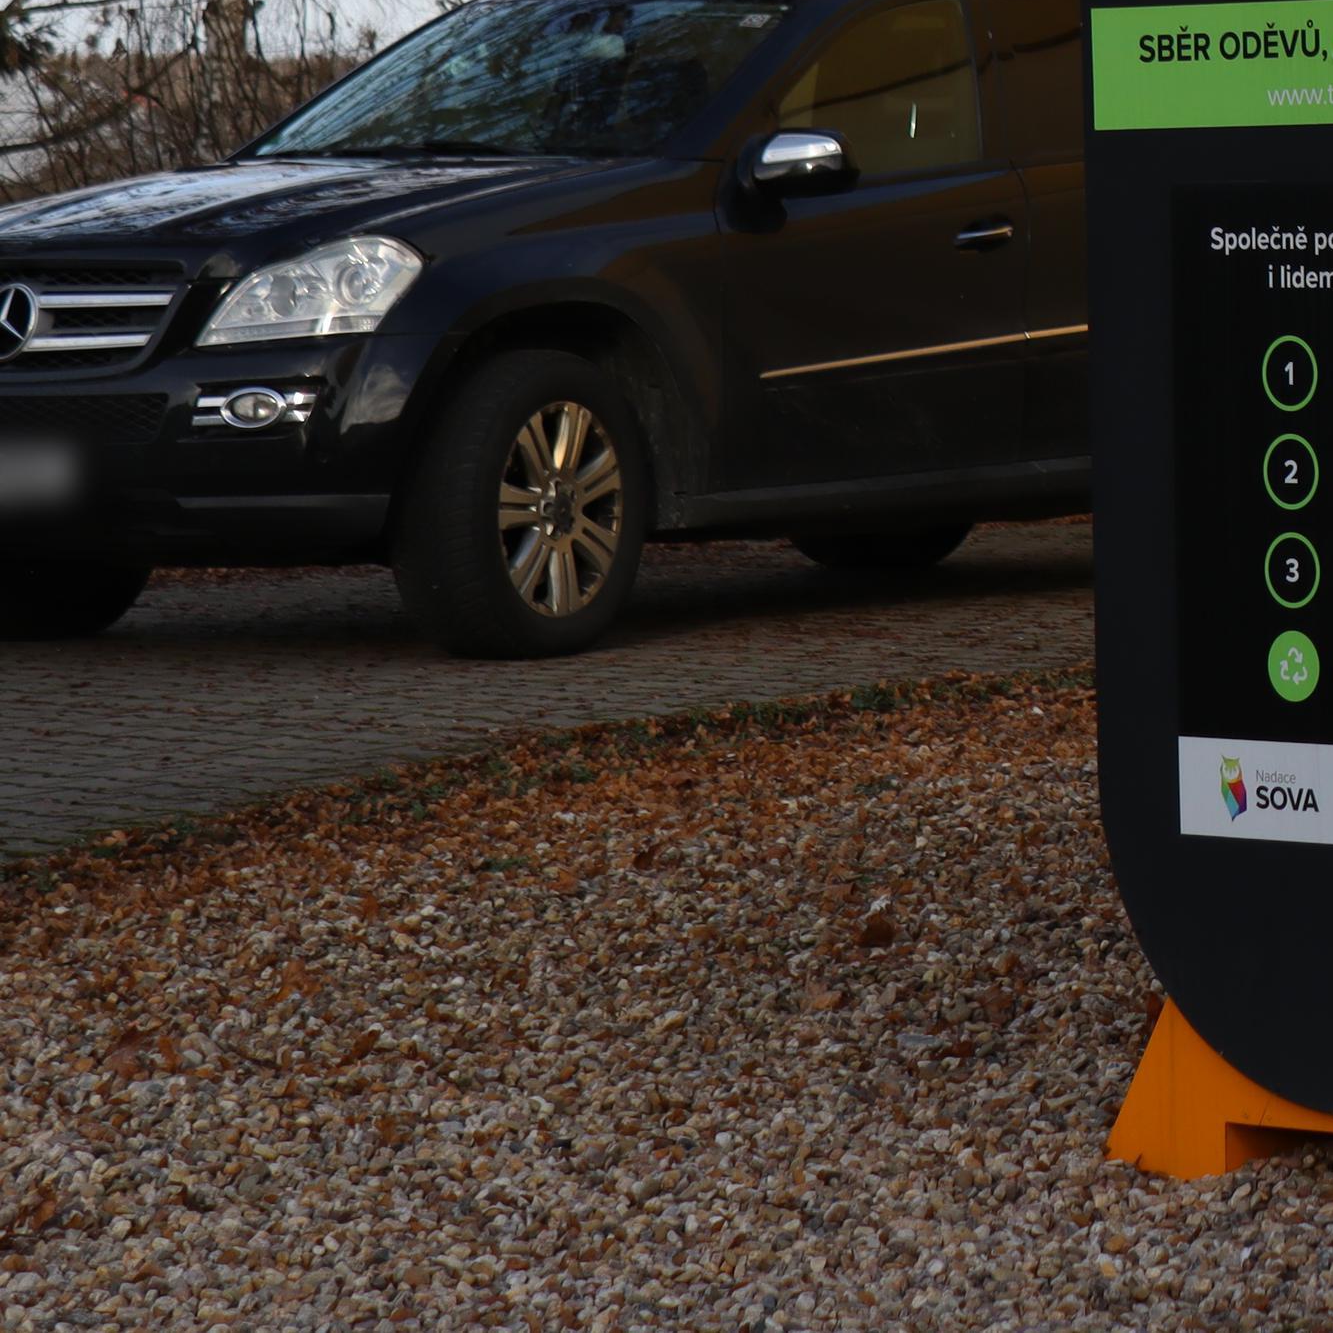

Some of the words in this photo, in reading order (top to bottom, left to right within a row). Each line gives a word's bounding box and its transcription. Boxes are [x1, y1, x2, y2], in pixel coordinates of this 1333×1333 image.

[1139, 25, 1210, 63] SBĚR
[1219, 19, 1328, 62] ODĚVŮ,
[1210, 226, 1308, 255] Společně
[1268, 265, 1274, 289] i
[1284, 362, 1294, 385] 1
[1284, 460, 1298, 484] 2
[1285, 558, 1300, 583] 3
[1255, 769, 1297, 784] Nadace
[1255, 786, 1319, 813] SOVA
